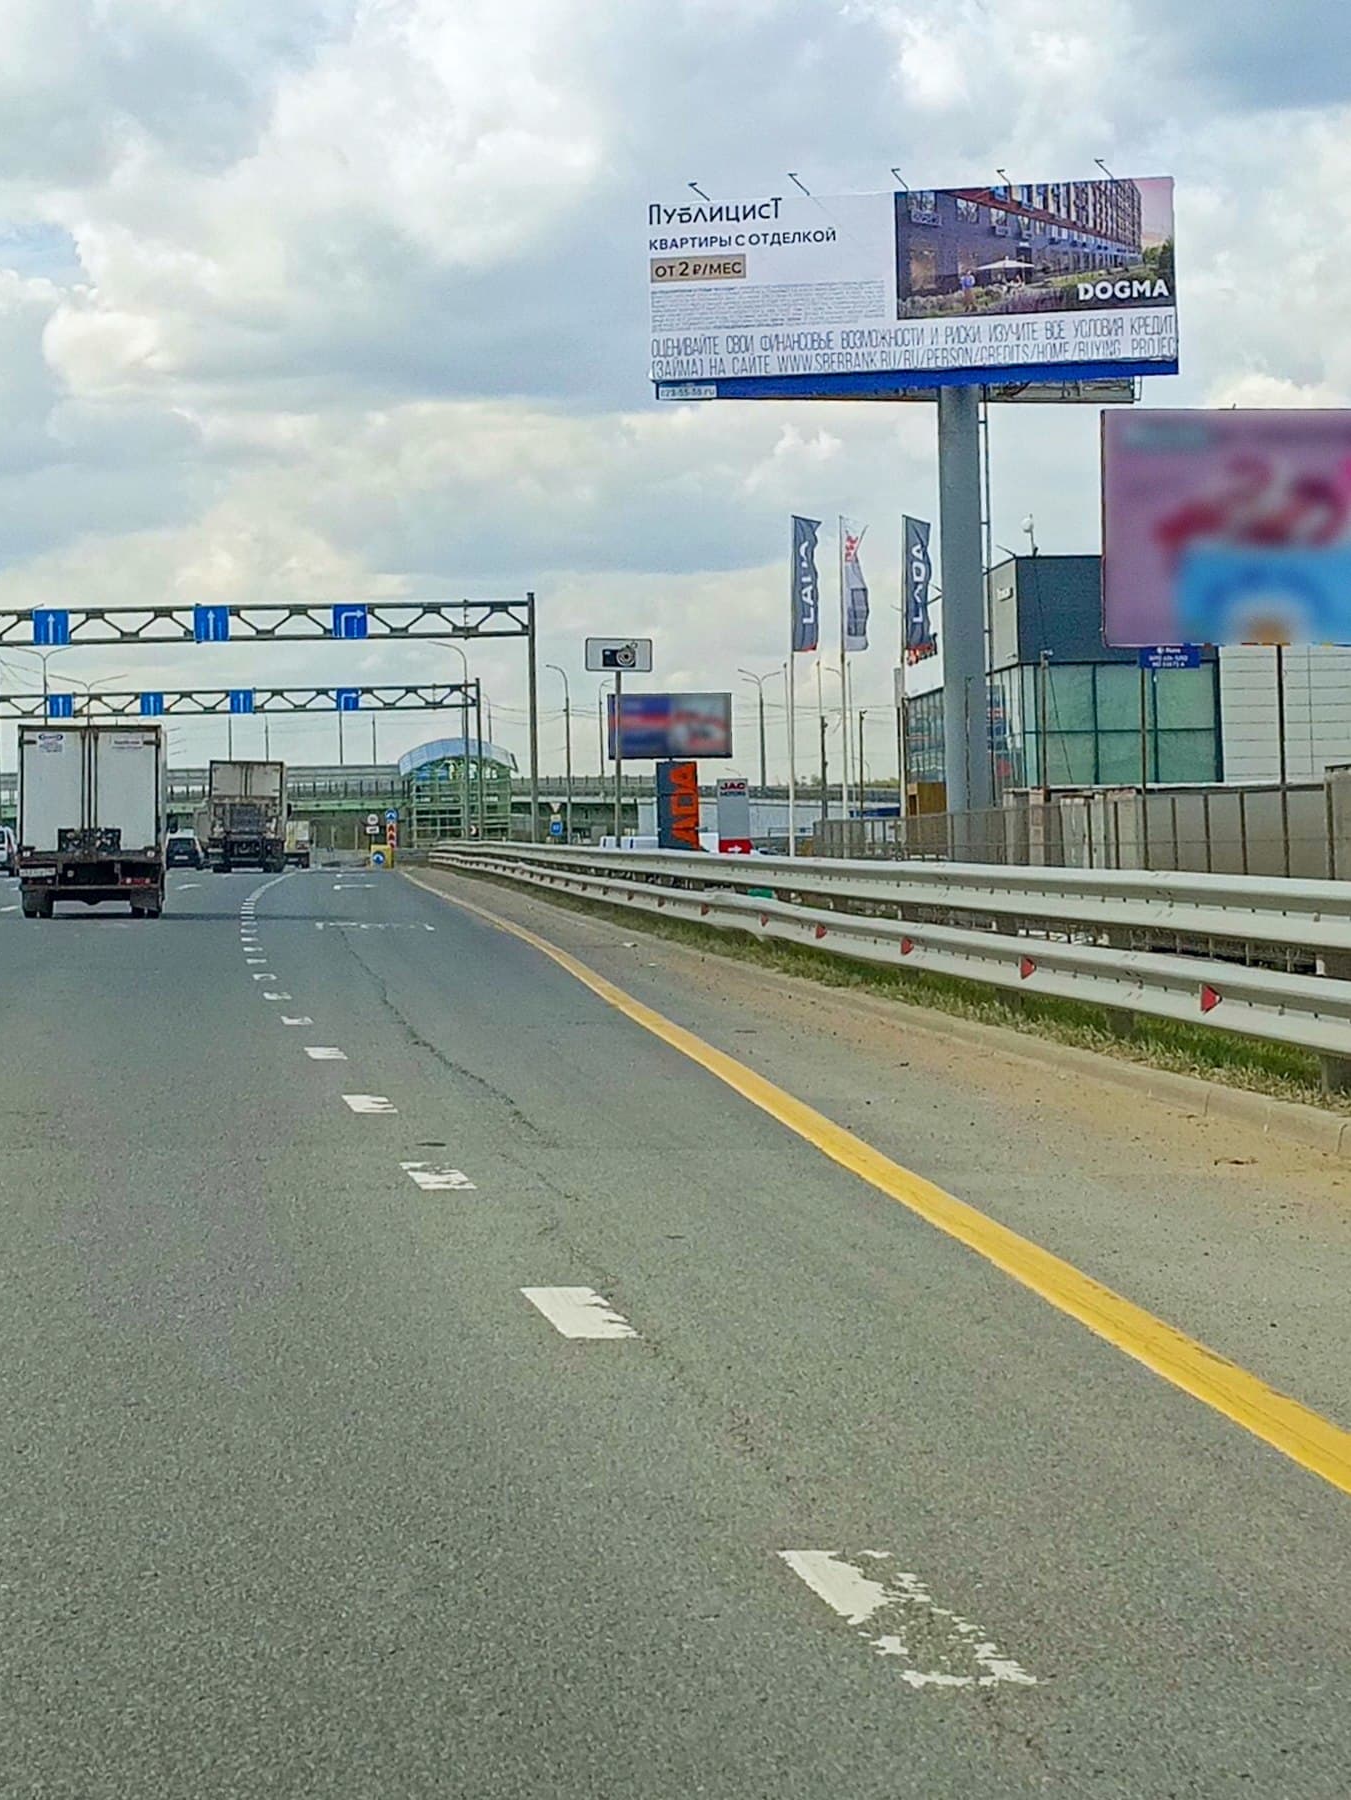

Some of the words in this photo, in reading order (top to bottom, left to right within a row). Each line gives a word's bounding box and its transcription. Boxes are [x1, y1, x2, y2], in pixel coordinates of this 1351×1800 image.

[649, 235, 732, 251] КВАРТИРЫ
[735, 234, 746, 246] С
[749, 226, 837, 247] ОТДЕЛКОЙ
[654, 264, 676, 278] ОТ
[678, 261, 690, 277] 2
[1077, 281, 1170, 301] DOGMA
[651, 334, 719, 358] ОЦЕНИВАЙТЕ
[726, 334, 754, 355] СВОИ
[841, 327, 924, 351] ВОЗМОЖНОСТИ
[930, 326, 939, 345] И
[945, 324, 982, 345] РИСКИ
[989, 322, 1039, 343] ИЗУЧИТЕ
[1044, 319, 1066, 340] ВСЕ
[1073, 317, 1124, 339] УСЛОВИЯ
[651, 355, 704, 379] (ЗАЙМА)
[709, 357, 726, 376] НА
[732, 352, 771, 374] САЙТЕ
[719, 782, 746, 791] JAC
[670, 763, 700, 851] ADA
